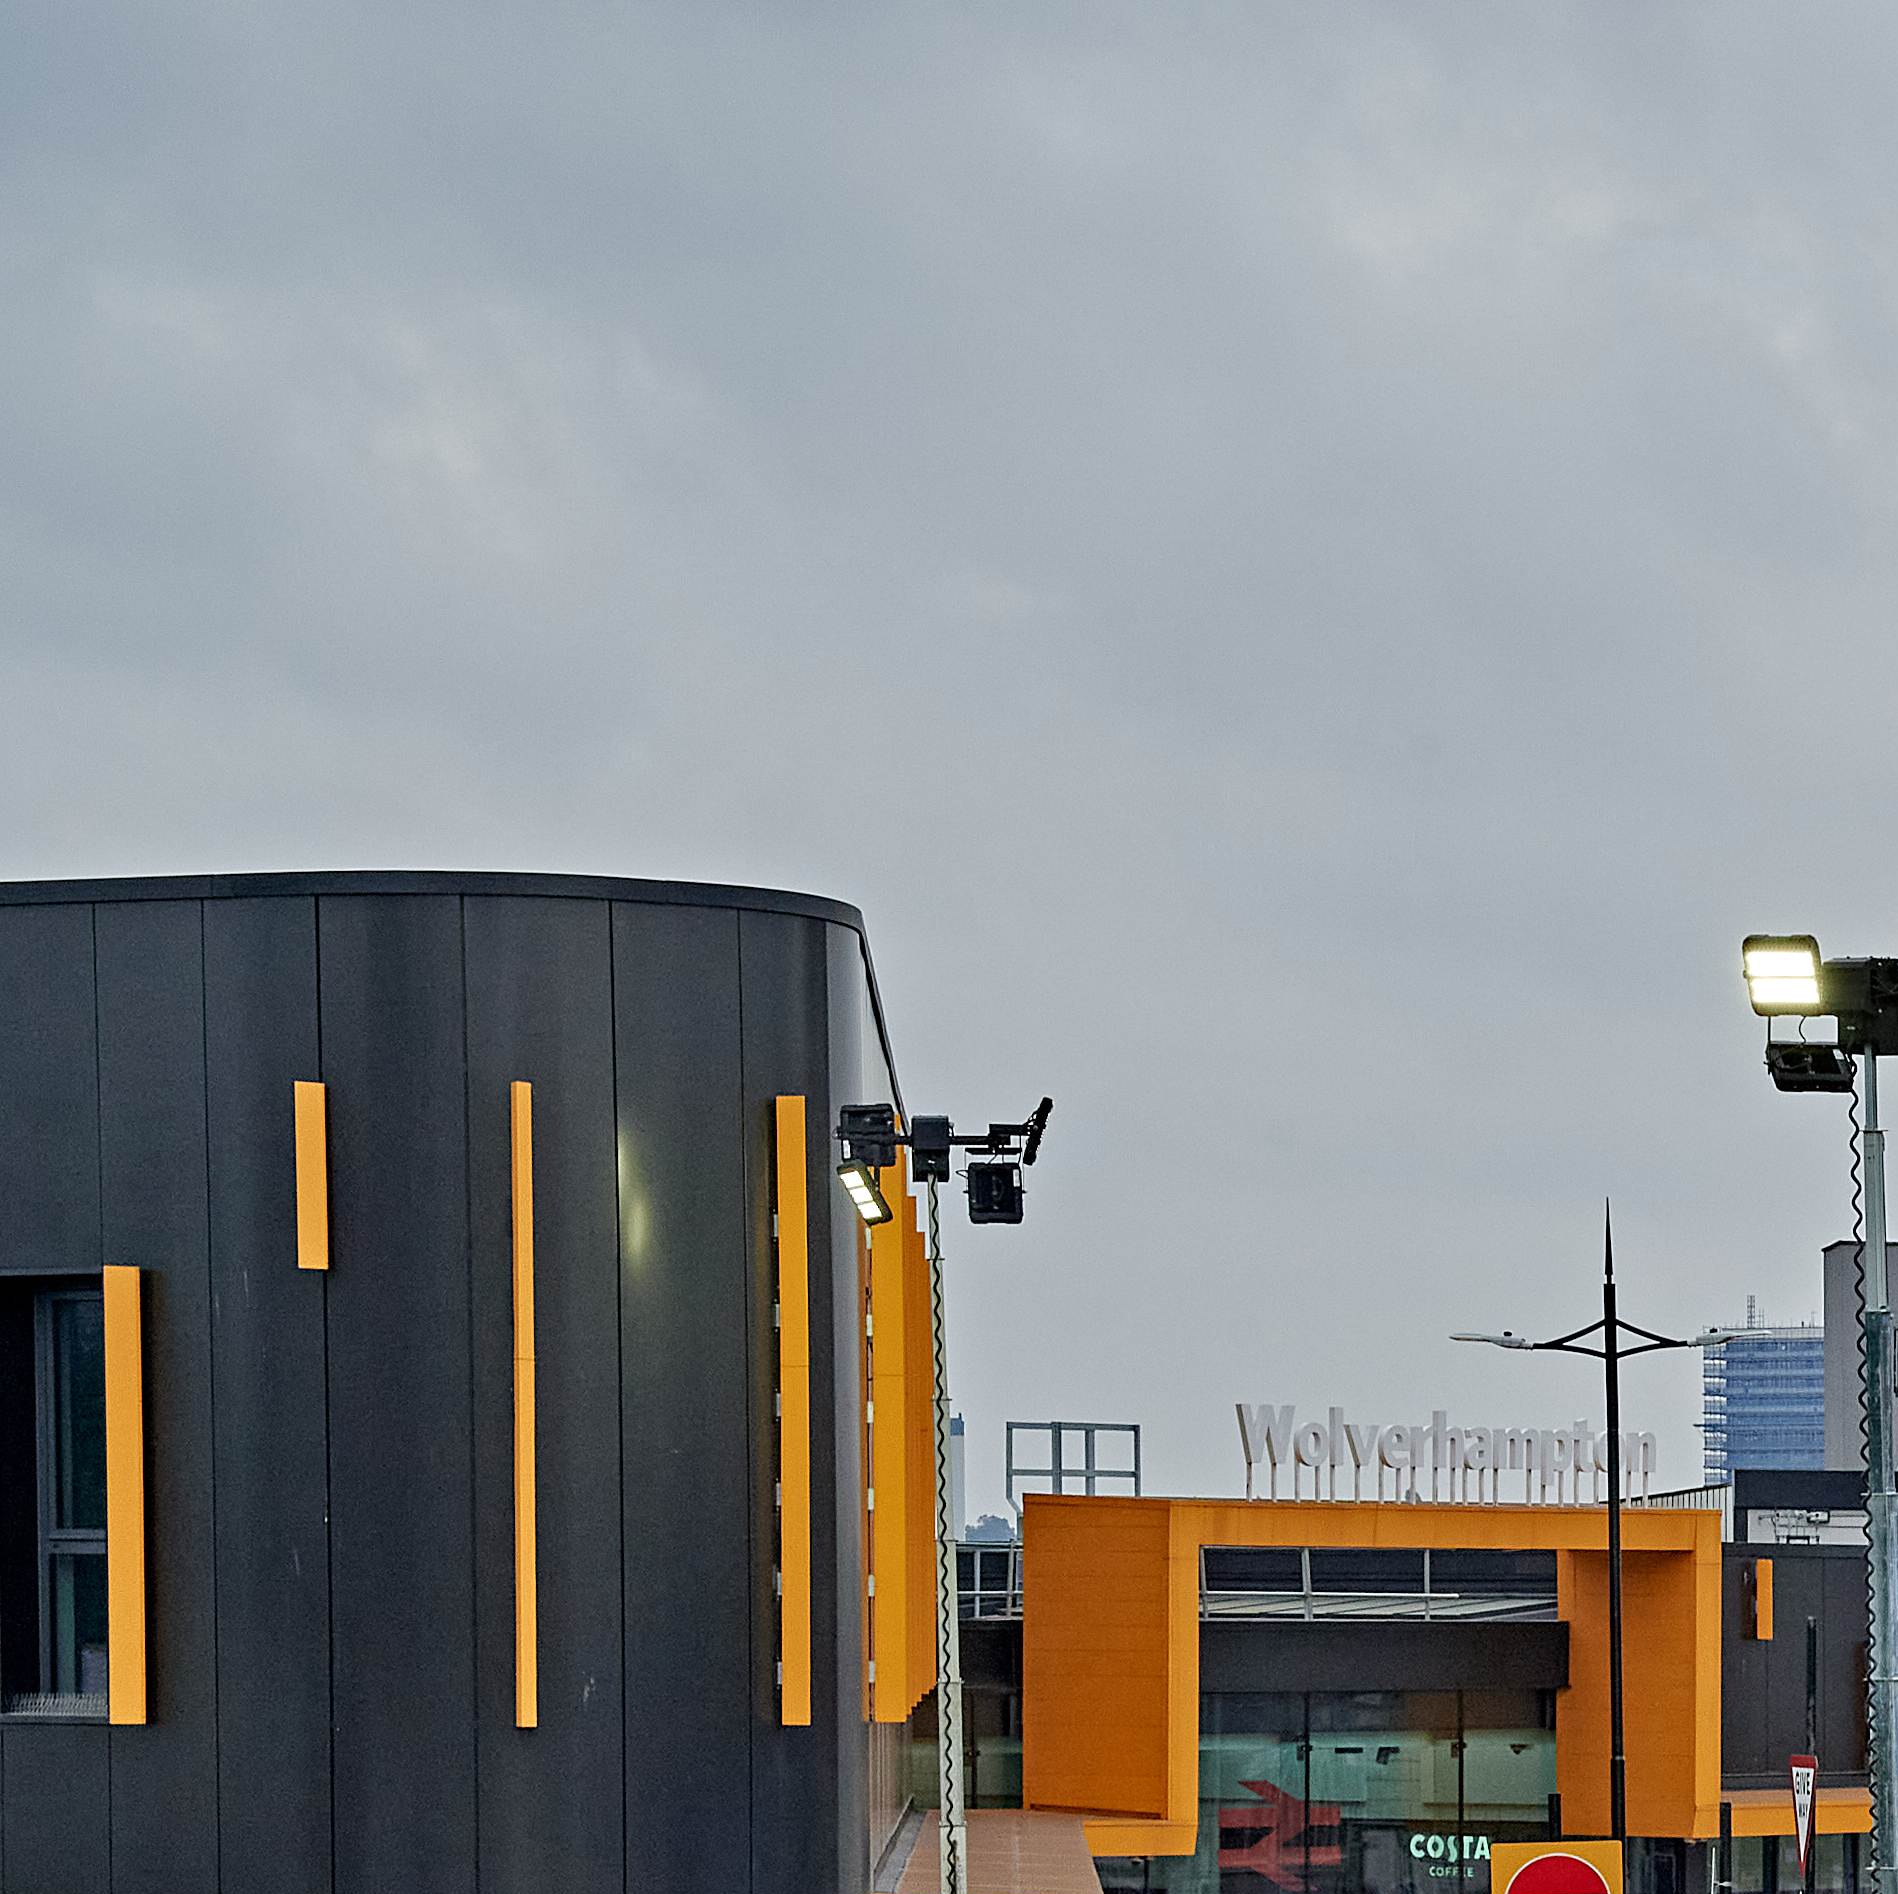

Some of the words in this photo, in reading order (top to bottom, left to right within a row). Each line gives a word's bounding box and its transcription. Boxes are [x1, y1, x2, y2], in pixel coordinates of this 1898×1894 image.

[1236, 1403, 1657, 1486] Wolverhampton
[1794, 1771, 1811, 1795] GIVE
[1409, 1833, 1491, 1863] COSTA
